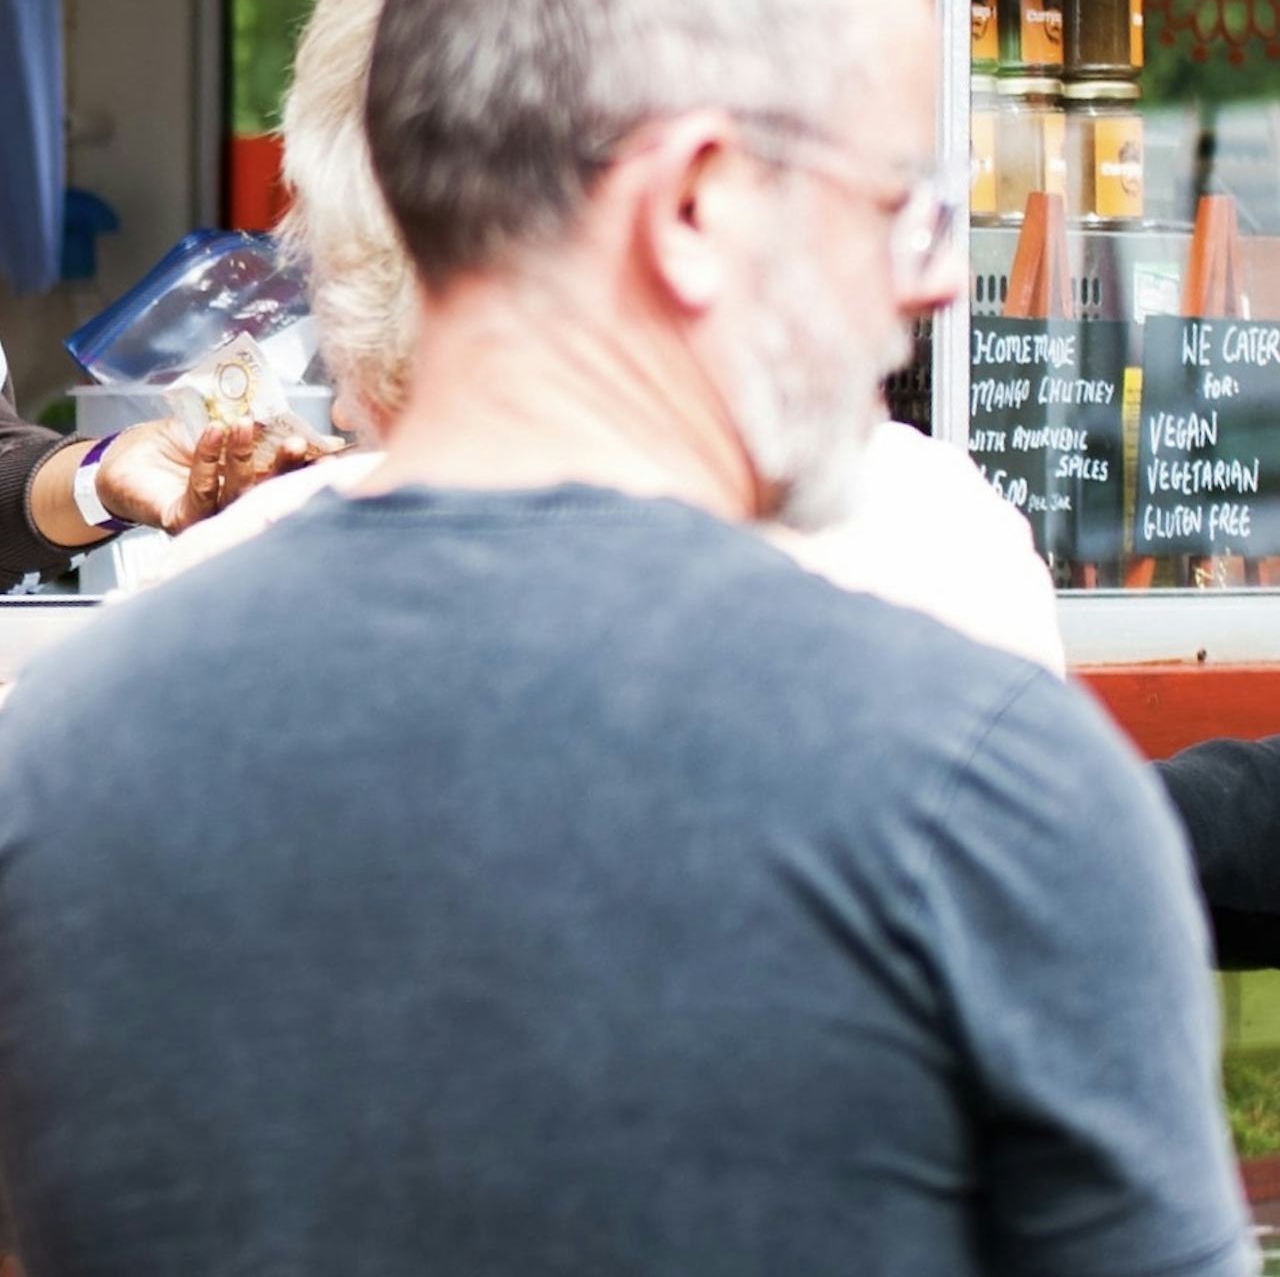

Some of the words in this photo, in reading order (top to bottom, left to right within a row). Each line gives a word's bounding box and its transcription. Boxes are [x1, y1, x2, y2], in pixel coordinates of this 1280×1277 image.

[1182, 323, 1213, 367] WE
[1222, 324, 1280, 367] CATER
[1038, 376, 1115, 405] CHUTNEY
[1011, 425, 1088, 452] AYURVEDIC
[1149, 410, 1218, 456] VEGAN
[1055, 455, 1109, 482] SPICES
[1147, 457, 1260, 495] VEGETARIAN
[1143, 503, 1203, 541] GLUTEN
[1209, 502, 1251, 541] FREE
